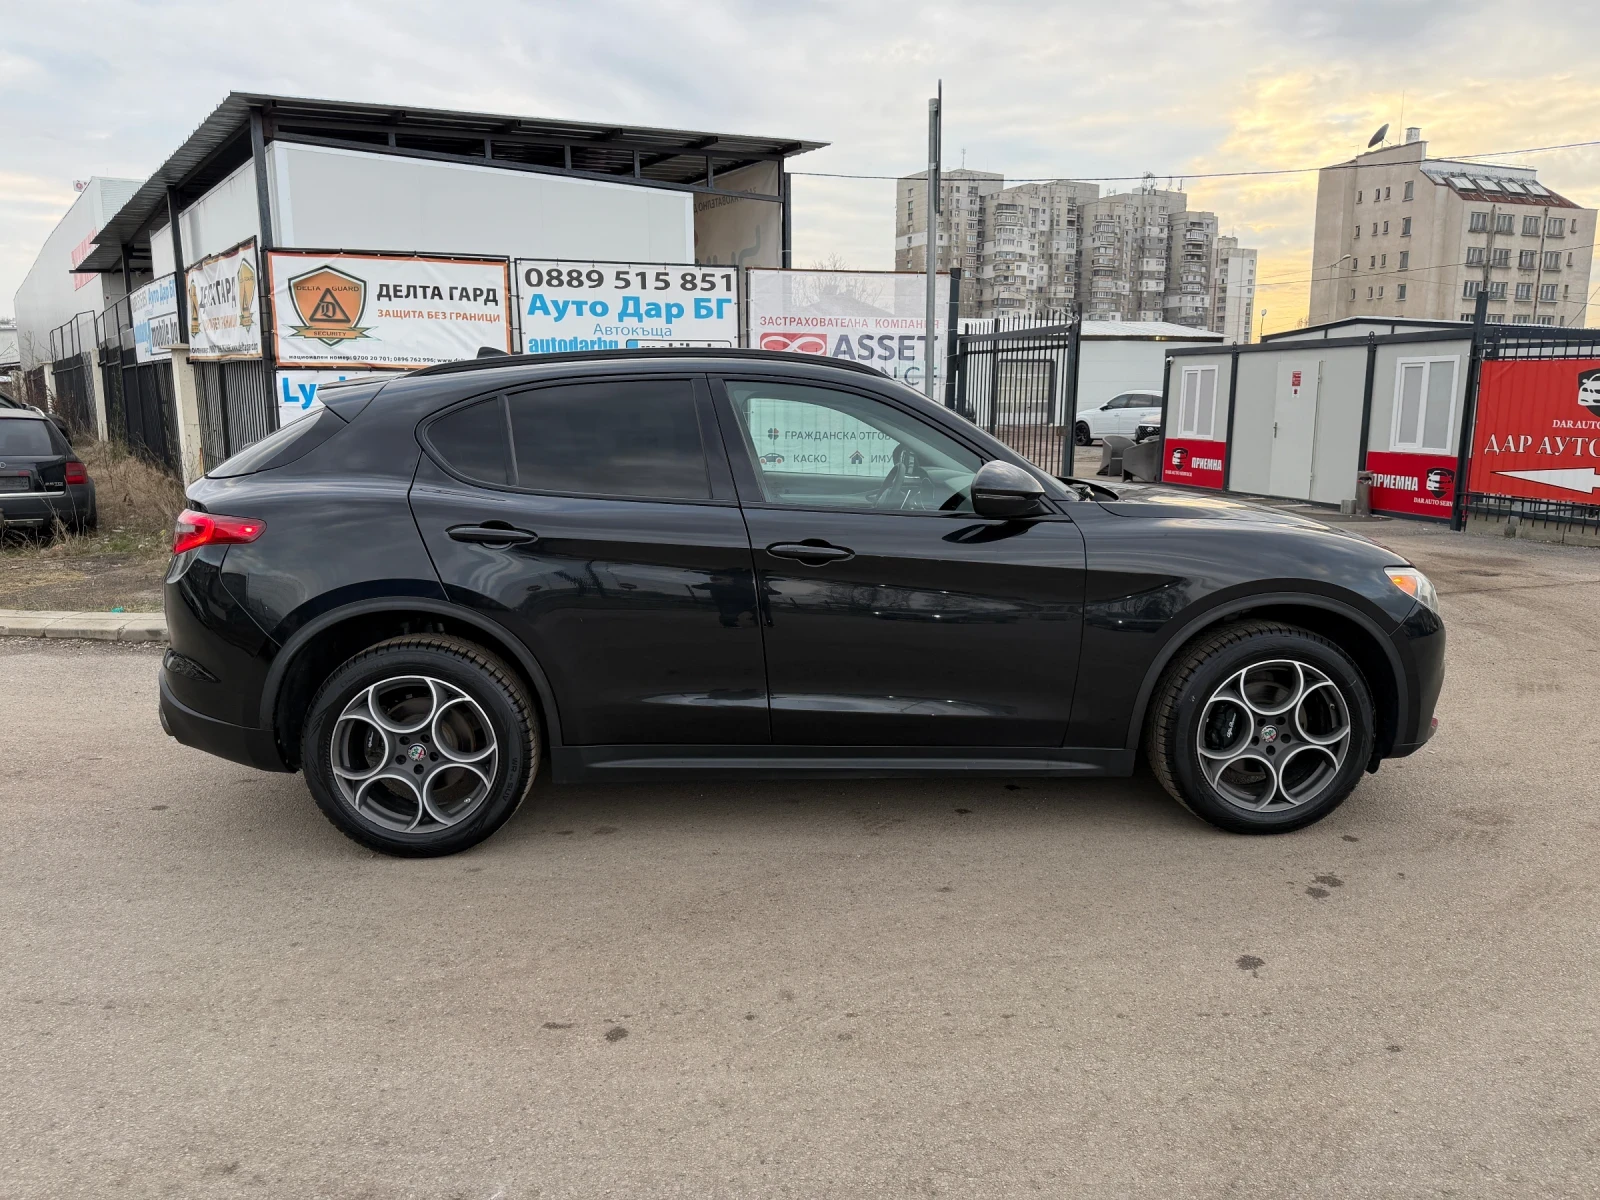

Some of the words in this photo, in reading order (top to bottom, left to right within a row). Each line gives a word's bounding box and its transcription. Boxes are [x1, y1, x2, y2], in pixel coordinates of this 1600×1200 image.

[524, 268, 604, 288] 0889
[614, 270, 670, 290] 515
[680, 272, 732, 292] 851
[377, 284, 443, 301] ДЕЛТА
[449, 286, 498, 306] ГАРД
[527, 293, 609, 322] Ауто
[618, 296, 684, 324] Дар
[694, 298, 732, 320] БГ
[378, 309, 424, 320] ЗАЩИТА
[427, 311, 446, 320] БЕЗ
[450, 312, 500, 323] ГРАНИЦИ
[760, 316, 868, 328] ЗАСТРАХОВАТЕЛНА
[875, 319, 939, 329] КОМПАНЯ
[593, 324, 672, 338] Автокъща
[1552, 420, 1574, 428] DAR
[784, 431, 856, 442] ГРАЖДАНСКА
[1484, 434, 1533, 456] ДАР
[793, 454, 827, 463] КАСКО
[1192, 457, 1222, 471] ПРИЕМНА
